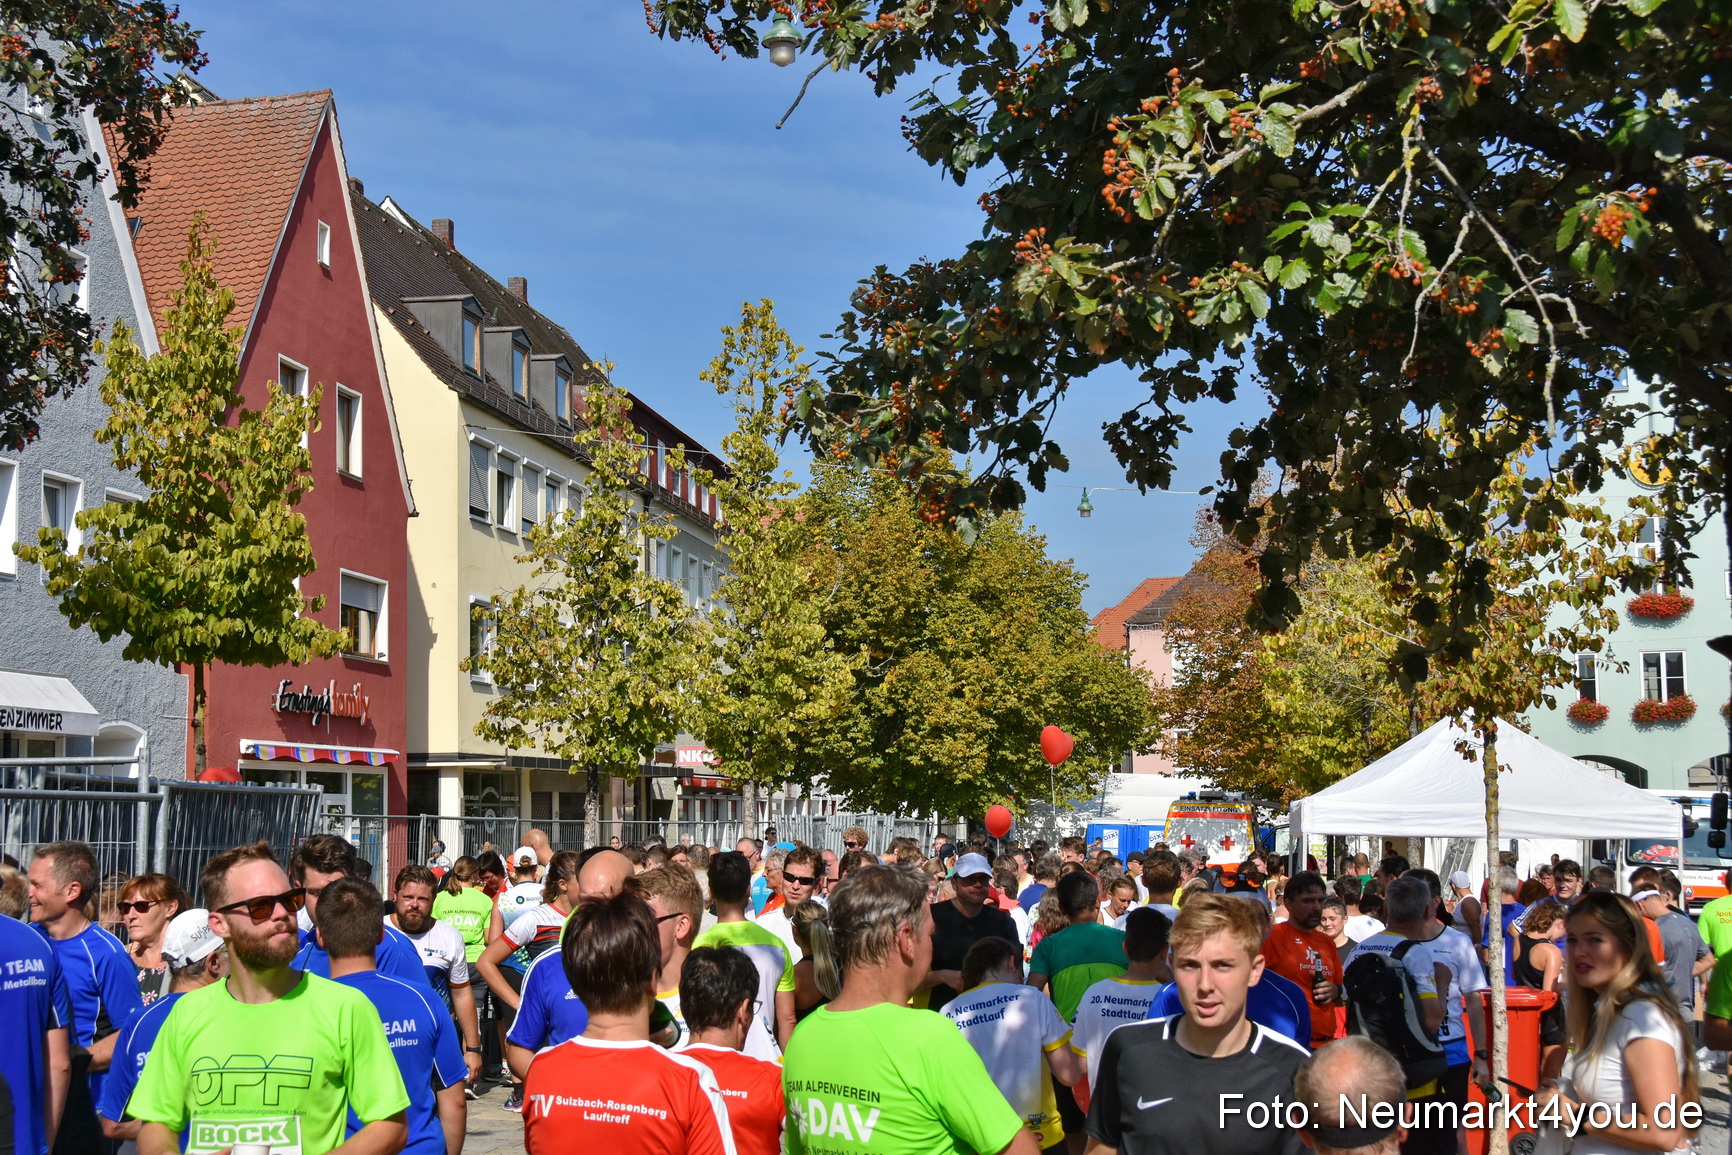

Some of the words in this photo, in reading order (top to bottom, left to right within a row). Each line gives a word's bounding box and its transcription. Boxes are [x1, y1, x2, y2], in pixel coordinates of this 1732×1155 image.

[330, 679, 371, 726] family
[0, 707, 63, 731] ENZIMMER
[679, 749, 715, 763] NKD
[1103, 831, 1118, 841] DIXI
[454, 914, 481, 928] DAV
[5, 958, 45, 976] TEAM
[4, 976, 47, 990] Metallbau
[954, 994, 1020, 1016] Neumarkter
[1090, 995, 1102, 1004] 20.
[1104, 995, 1153, 1008] Neumarkt
[956, 1008, 1006, 1030] Stadtlauf
[1101, 1008, 1147, 1021] Stadtlauf
[382, 1018, 417, 1036] EAM
[390, 1037, 419, 1048] allbau
[805, 1080, 880, 1104] ALPENVEREIN
[530, 1094, 555, 1117] TV
[555, 1095, 668, 1120] Sulzbach-Rosenberg
[583, 1110, 631, 1125] Lauftreff
[808, 1097, 880, 1143] DAV
[198, 1122, 287, 1145] BOCK
